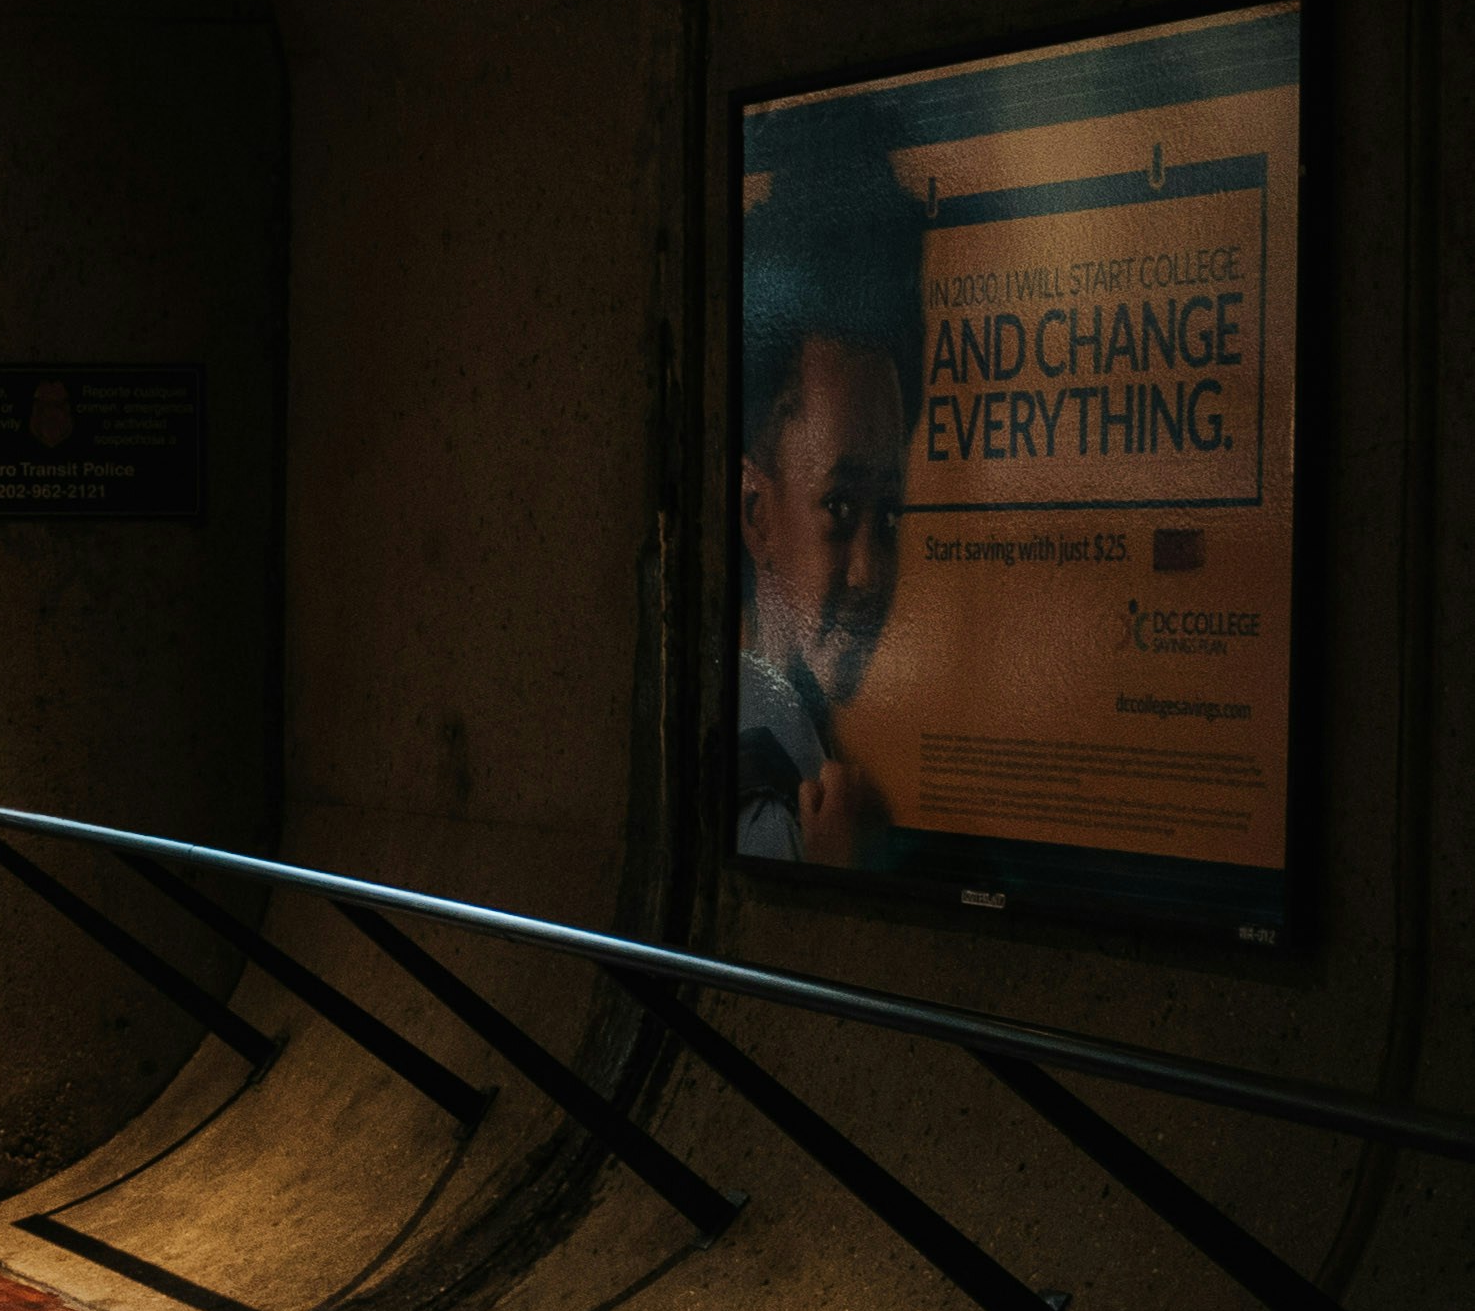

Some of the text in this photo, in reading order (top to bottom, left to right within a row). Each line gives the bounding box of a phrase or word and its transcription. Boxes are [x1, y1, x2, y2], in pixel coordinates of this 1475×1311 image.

[929, 277, 949, 309] IN
[1006, 273, 1012, 302] I
[1015, 267, 1065, 301] WILL
[1069, 256, 1135, 296] START
[930, 292, 1243, 385] AND CHANGE
[927, 379, 1233, 462] EVERYTHING.
[20, 462, 77, 477] Transit
[83, 462, 135, 477] Police
[924, 535, 962, 563] Start
[964, 534, 1014, 568] saving
[1018, 535, 1056, 563] with
[1057, 535, 1090, 566] just
[1153, 611, 1261, 637] DC COLLEGE
[1115, 692, 1252, 722] dccollegesavings.com
